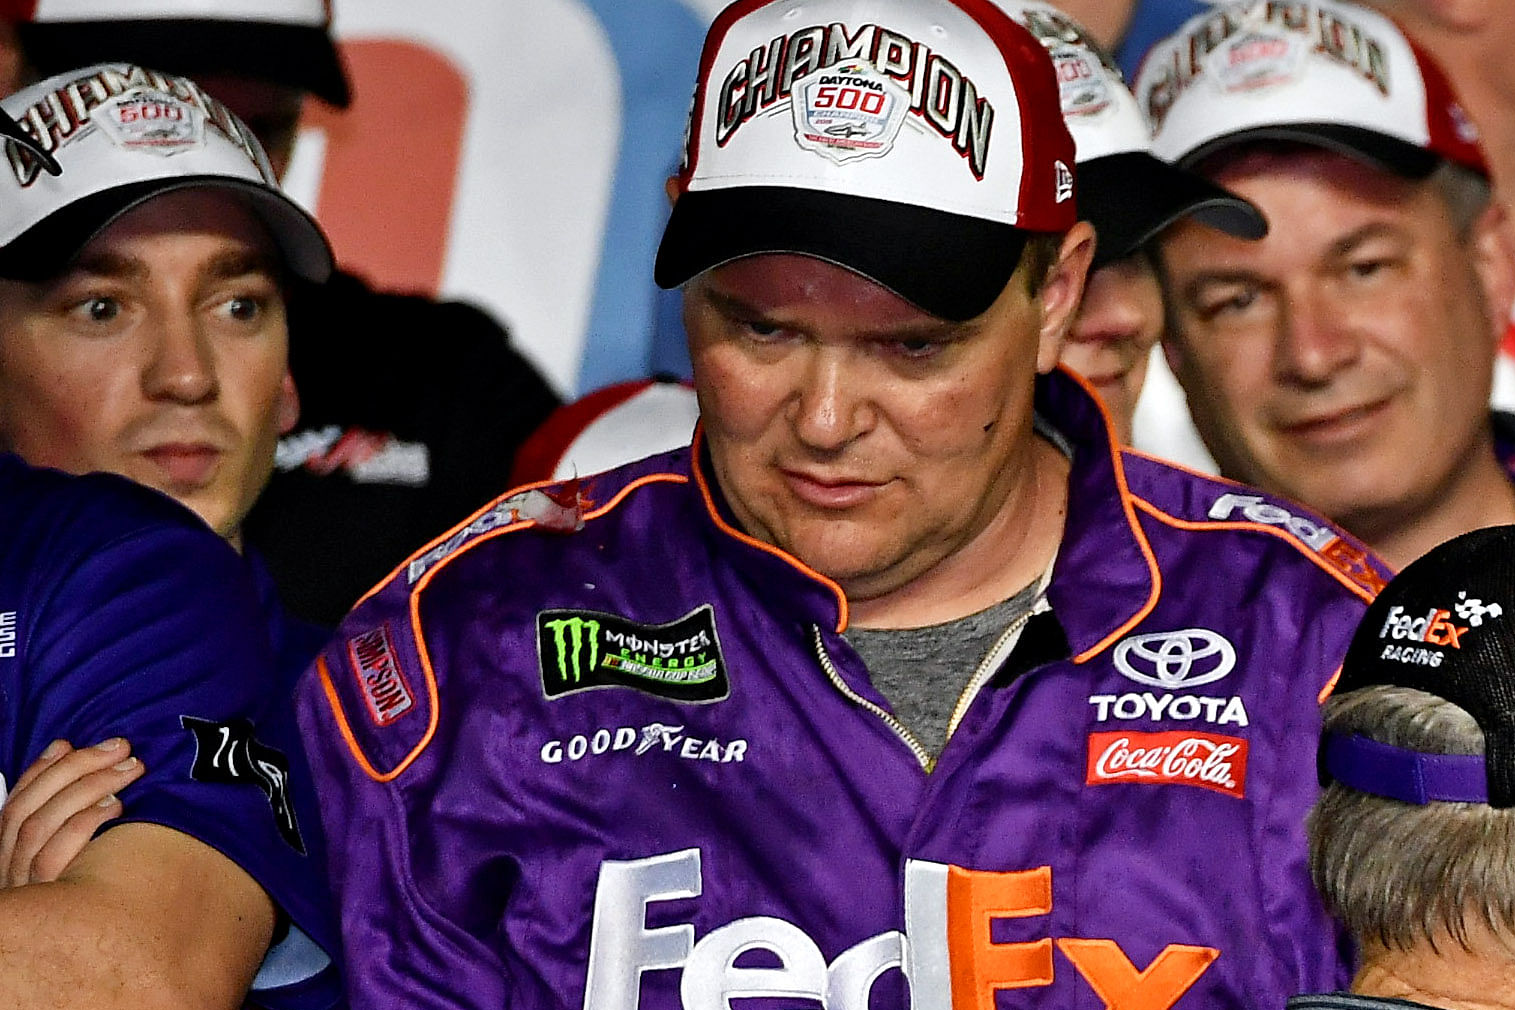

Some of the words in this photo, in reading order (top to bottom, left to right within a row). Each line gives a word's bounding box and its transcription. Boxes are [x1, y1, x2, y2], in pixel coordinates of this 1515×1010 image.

[819, 76, 883, 92] DAYTONA
[716, 22, 995, 182] CHAMPION
[814, 87, 886, 115] 500
[1379, 606, 1469, 649] FedEx
[605, 630, 711, 658] MONSTER
[620, 648, 707, 668] ENERGY
[1380, 644, 1445, 667] RACING
[353, 627, 406, 716] SIMPSON
[1089, 693, 1249, 727] TOYOTA
[1096, 738, 1240, 788] Coca-Cola
